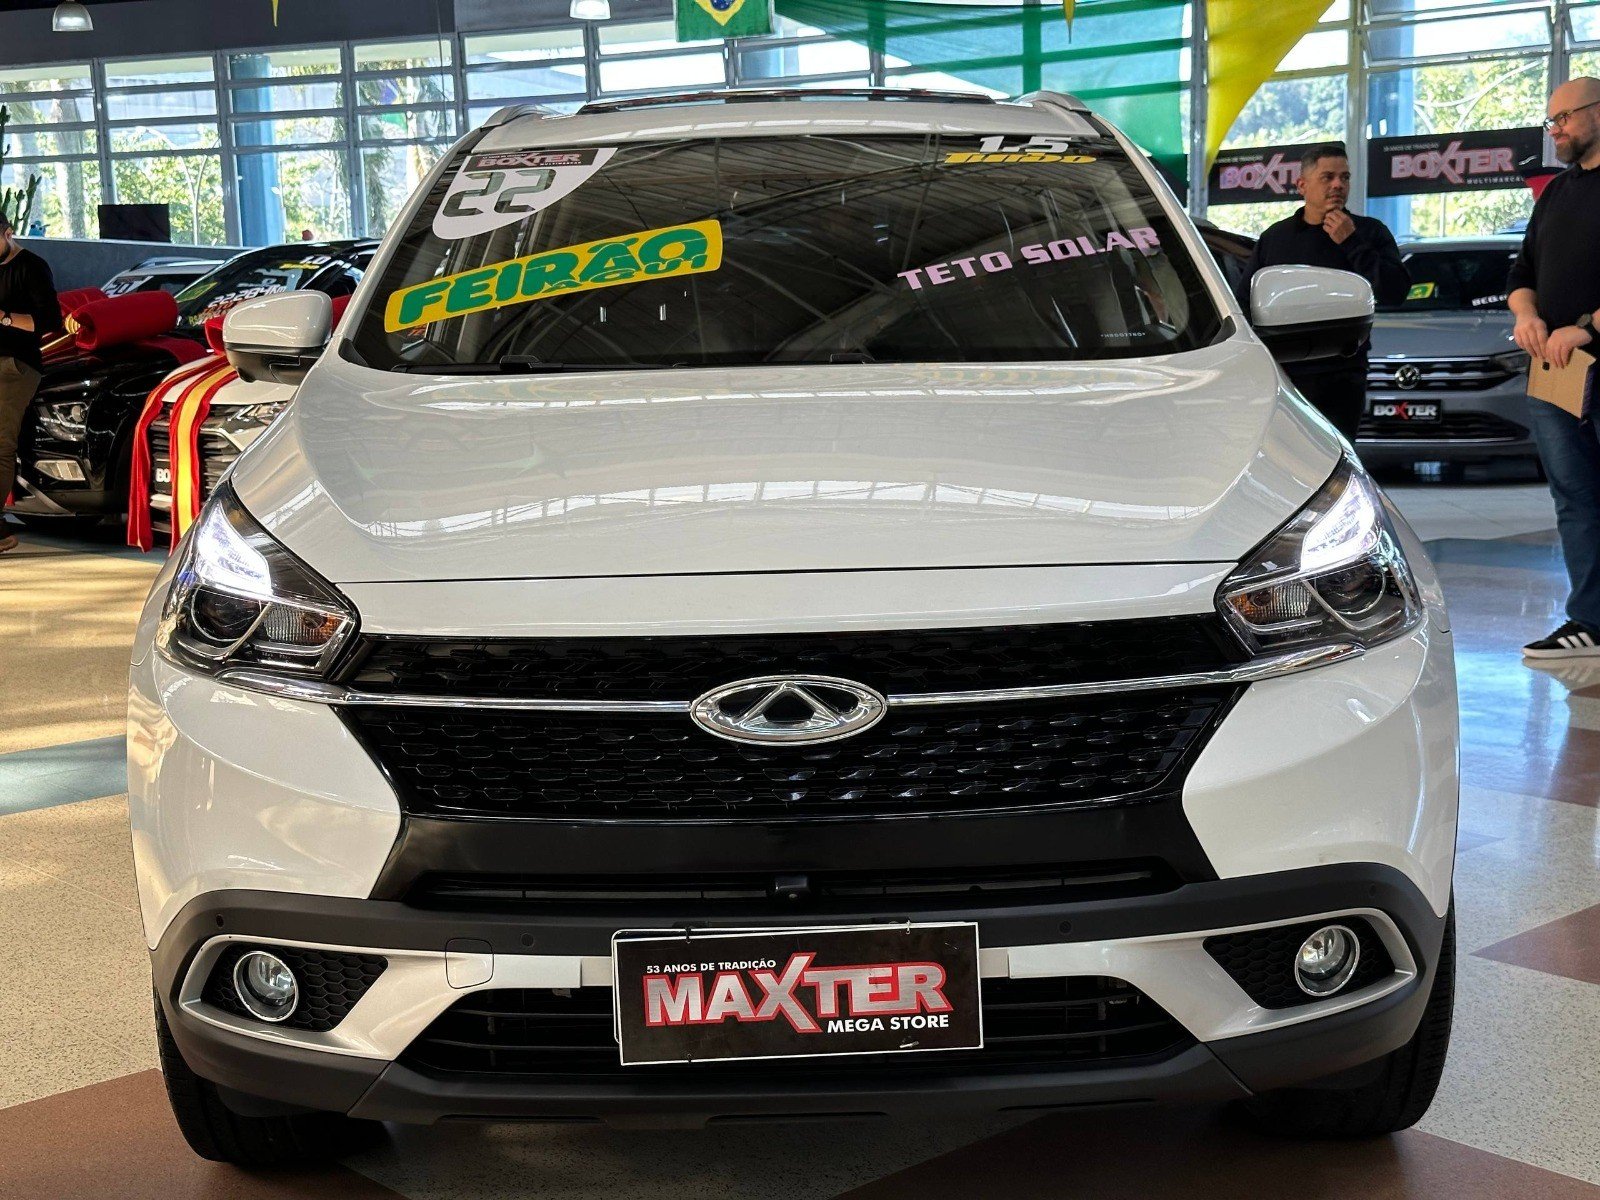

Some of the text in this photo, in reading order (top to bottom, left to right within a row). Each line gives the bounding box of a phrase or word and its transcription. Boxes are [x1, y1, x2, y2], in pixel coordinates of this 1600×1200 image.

[476, 152, 582, 168] BOXTER
[980, 135, 1072, 153] 1.5
[1390, 140, 1515, 185] BOXTER
[442, 169, 557, 218] 22
[1219, 152, 1302, 194] BOXT
[399, 228, 709, 325] FEIRÃO
[897, 226, 1162, 290] TETO SOLAR
[1373, 402, 1438, 420] BOXTER
[646, 958, 777, 974] 53 ANOS DE TRADIÇÃO
[643, 952, 954, 1034] MAXTER
[827, 1014, 949, 1034] MEGA STORE
